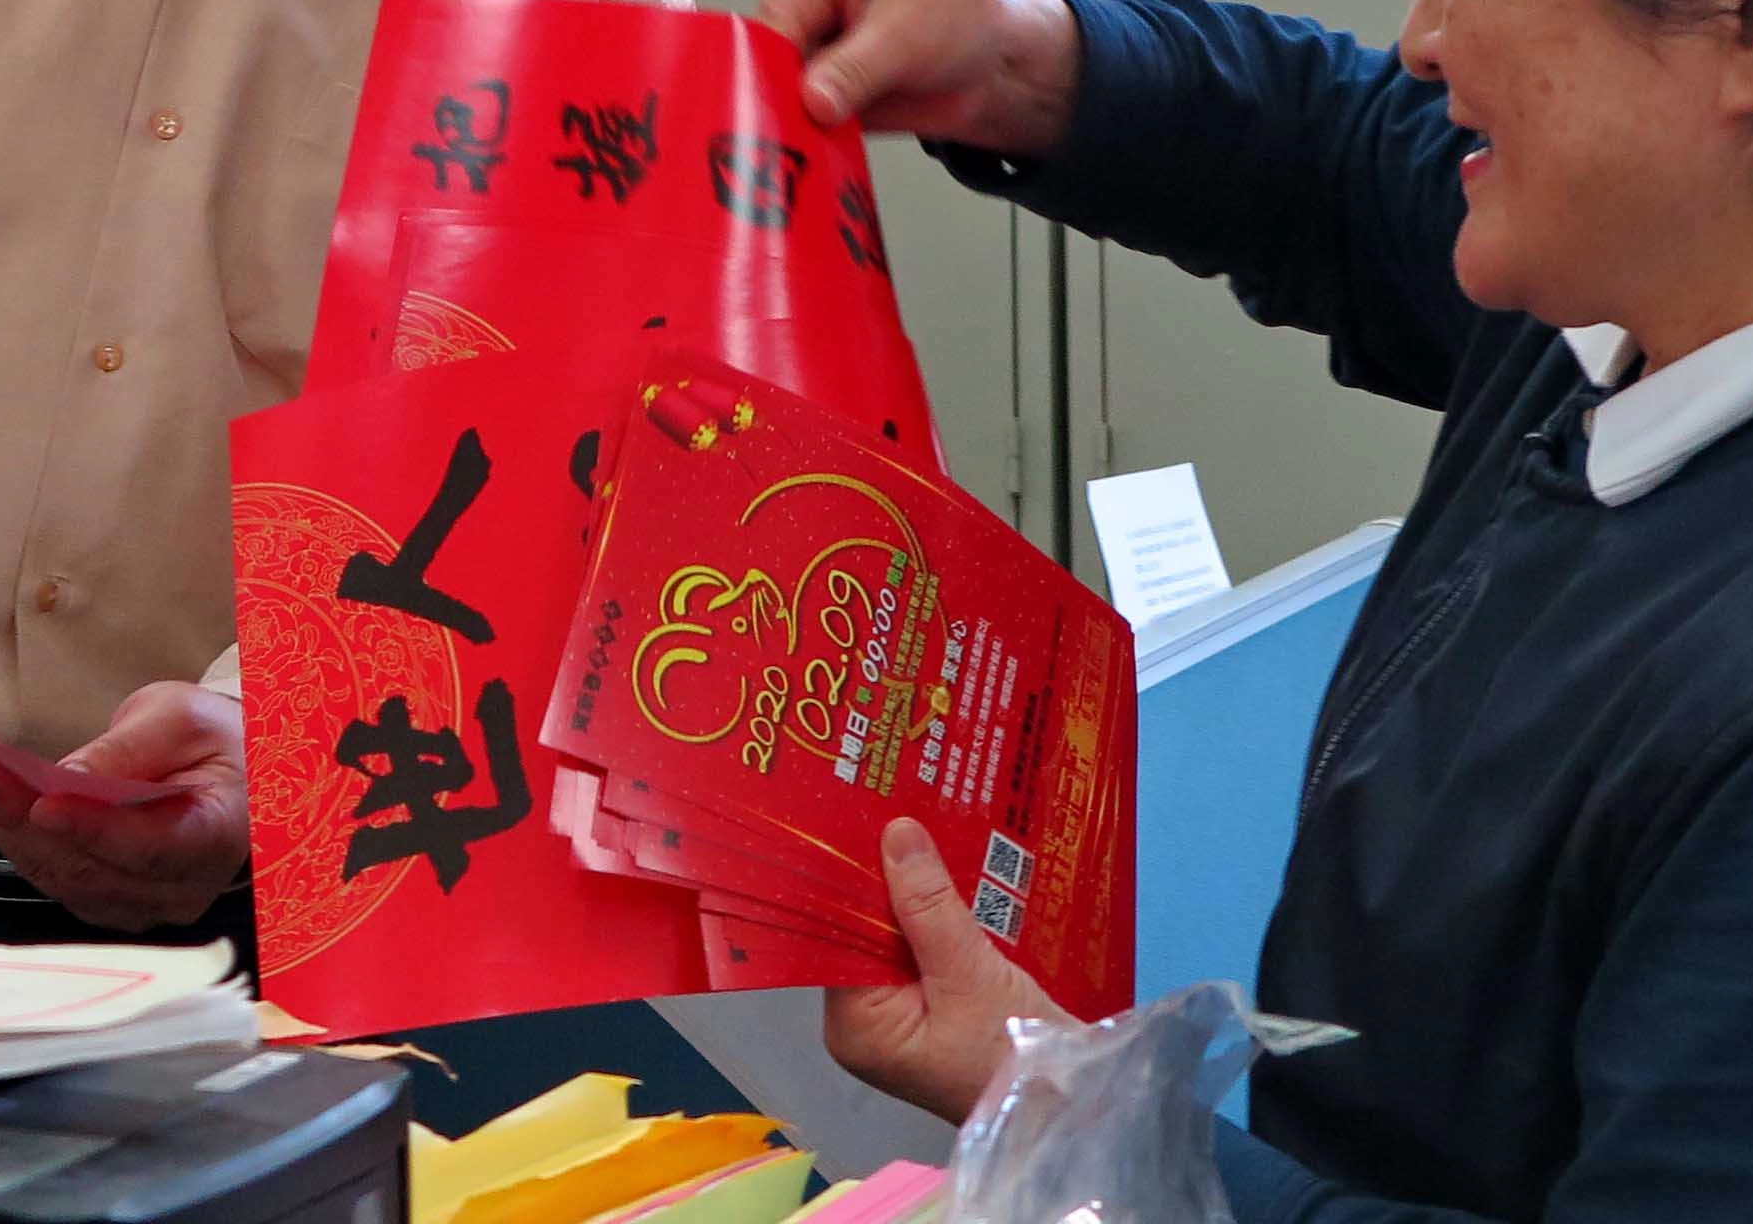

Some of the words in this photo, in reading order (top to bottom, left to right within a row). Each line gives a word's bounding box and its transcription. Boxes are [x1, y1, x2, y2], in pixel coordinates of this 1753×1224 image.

[739, 662, 790, 773] 2020
[796, 568, 872, 740] 02.09
[832, 709, 871, 784] 星期日
[861, 587, 897, 683] 09:00
